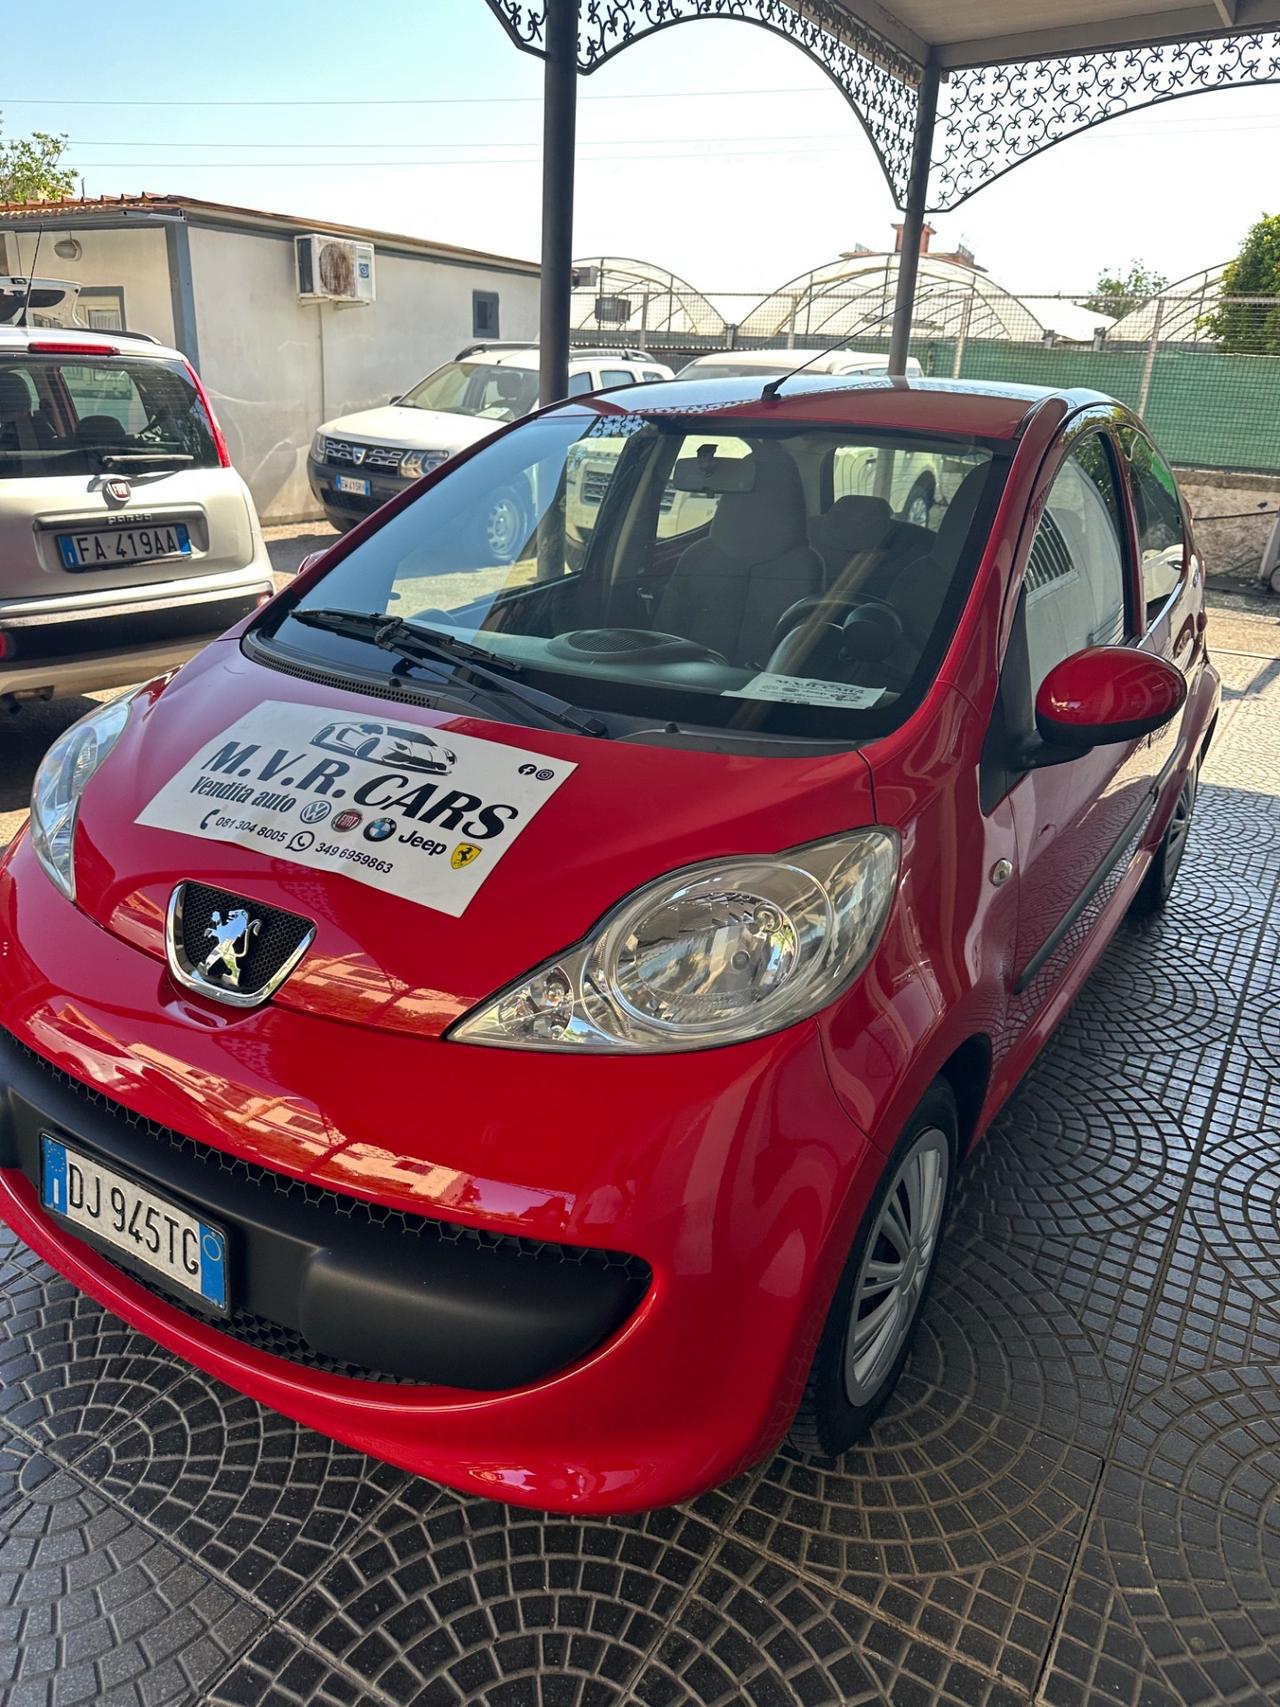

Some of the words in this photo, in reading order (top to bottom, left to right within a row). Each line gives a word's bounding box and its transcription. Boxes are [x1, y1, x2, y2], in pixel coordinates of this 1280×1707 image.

[77, 536, 107, 562] FA
[116, 529, 178, 558] 419AA
[190, 776, 255, 804] Vendita
[251, 791, 297, 813] auto
[215, 816, 237, 828] 081
[257, 827, 288, 841] 8005
[338, 814, 359, 828] FIAT
[315, 842, 340, 857] 349
[338, 848, 394, 874] 6959863
[398, 830, 447, 856] Jeep
[69, 1163, 101, 1218] DJ
[111, 1186, 199, 1275] 945TG
